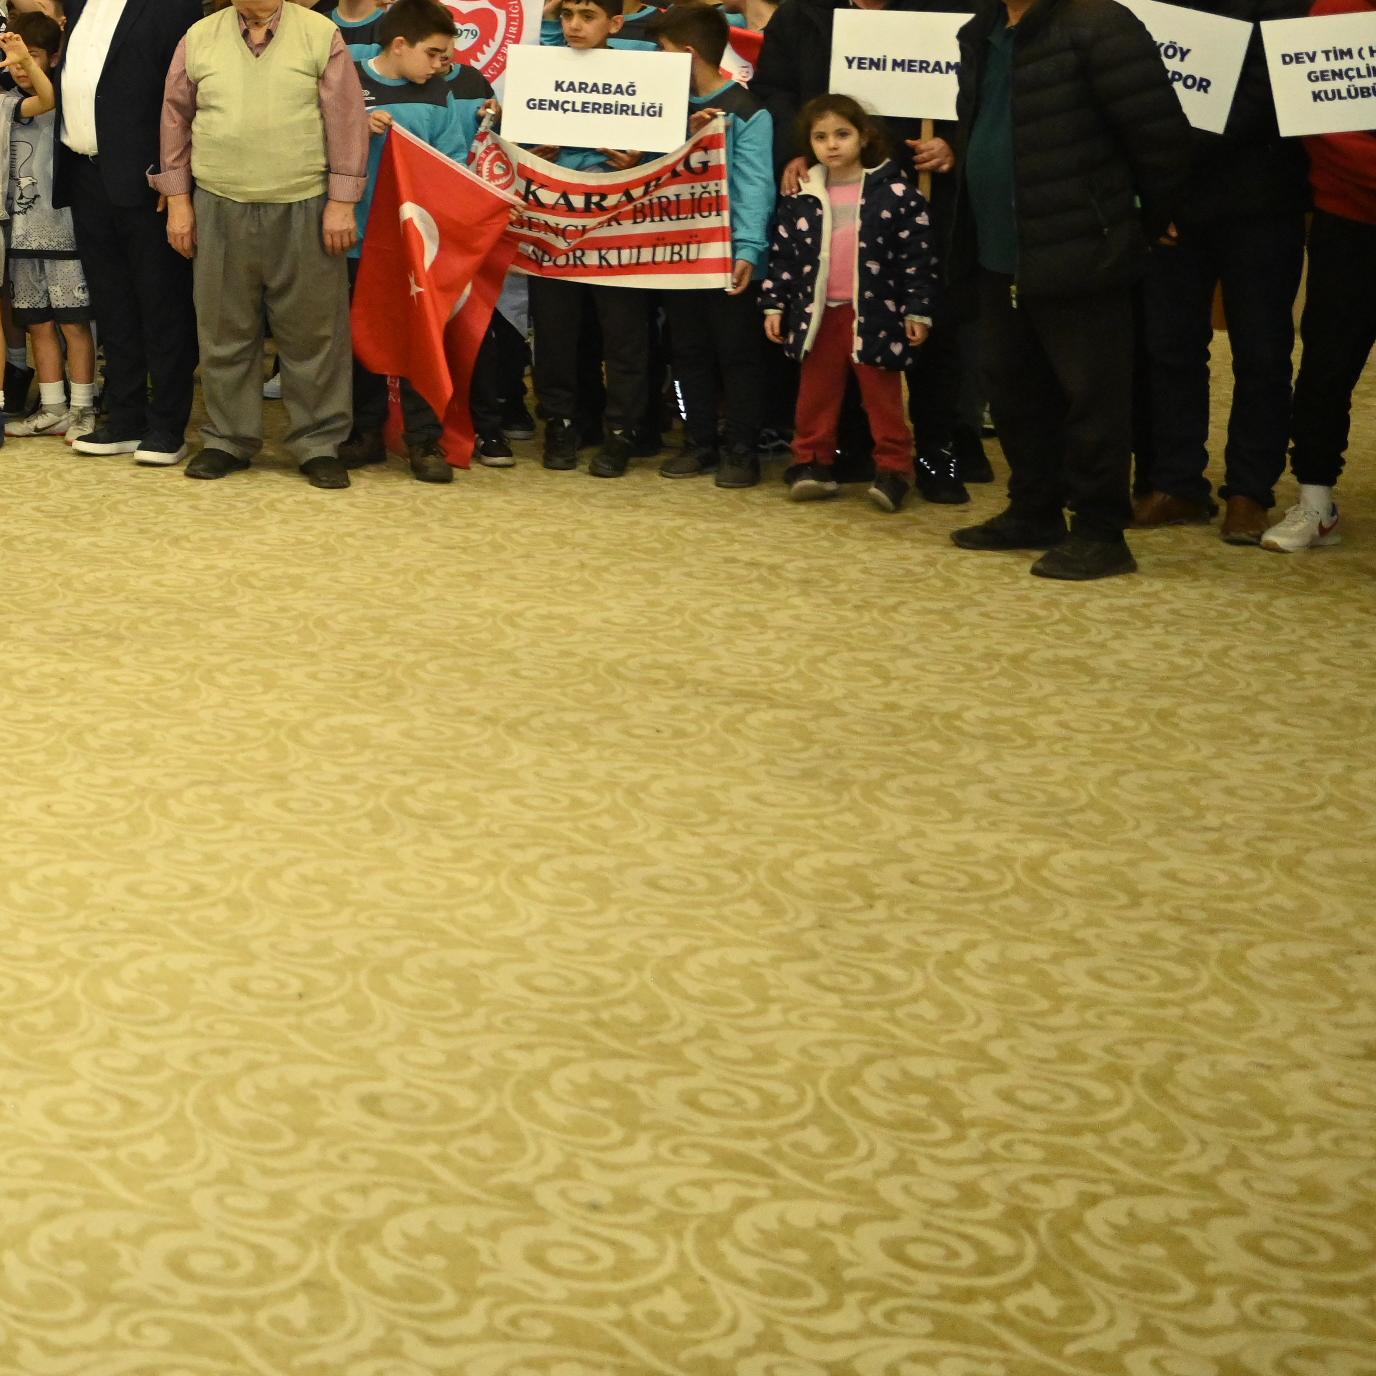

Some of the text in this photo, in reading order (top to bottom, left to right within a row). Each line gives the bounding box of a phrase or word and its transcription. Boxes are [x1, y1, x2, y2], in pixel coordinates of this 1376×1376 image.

[455, 28, 479, 40] 979
[1153, 41, 1192, 62] ÖY
[1281, 50, 1317, 66] DEV
[1321, 46, 1354, 62] TİM
[845, 55, 961, 75] YENİ MERAM
[554, 80, 637, 97] KARABAĞ
[1167, 70, 1212, 94] POR
[526, 98, 663, 118] GENÇLERBİRLİĞİ
[598, 234, 702, 269] KULÜBÜ
